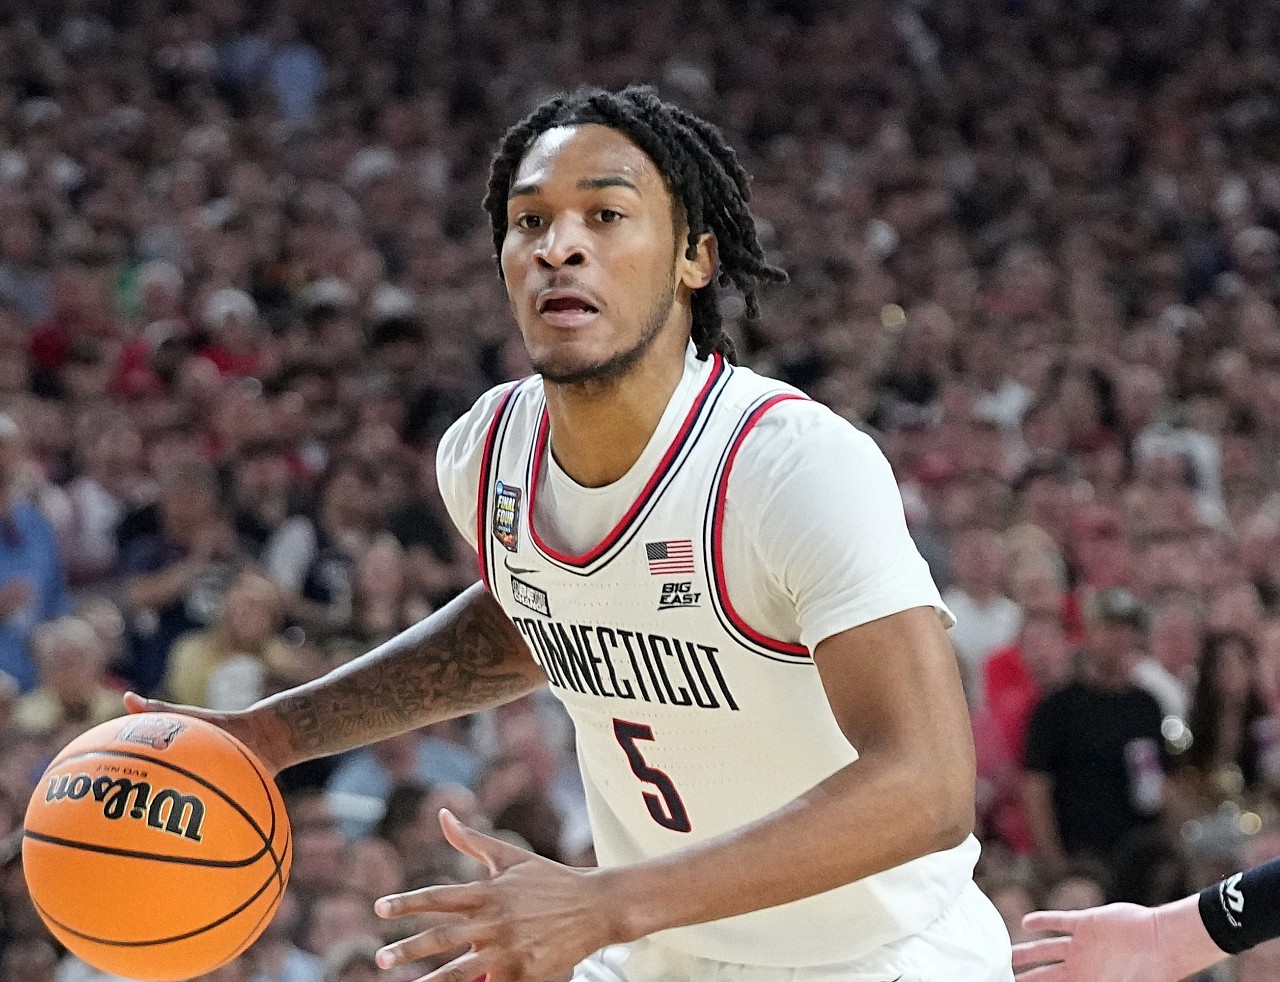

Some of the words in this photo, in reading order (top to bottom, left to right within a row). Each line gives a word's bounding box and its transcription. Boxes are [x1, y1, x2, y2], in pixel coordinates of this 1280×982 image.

[498, 494, 516, 512] FINAL
[497, 508, 515, 526] FOUR
[662, 582, 692, 593] BIG
[659, 592, 702, 605] EAST
[612, 717, 692, 833] 5
[45, 772, 206, 843] Wilson
